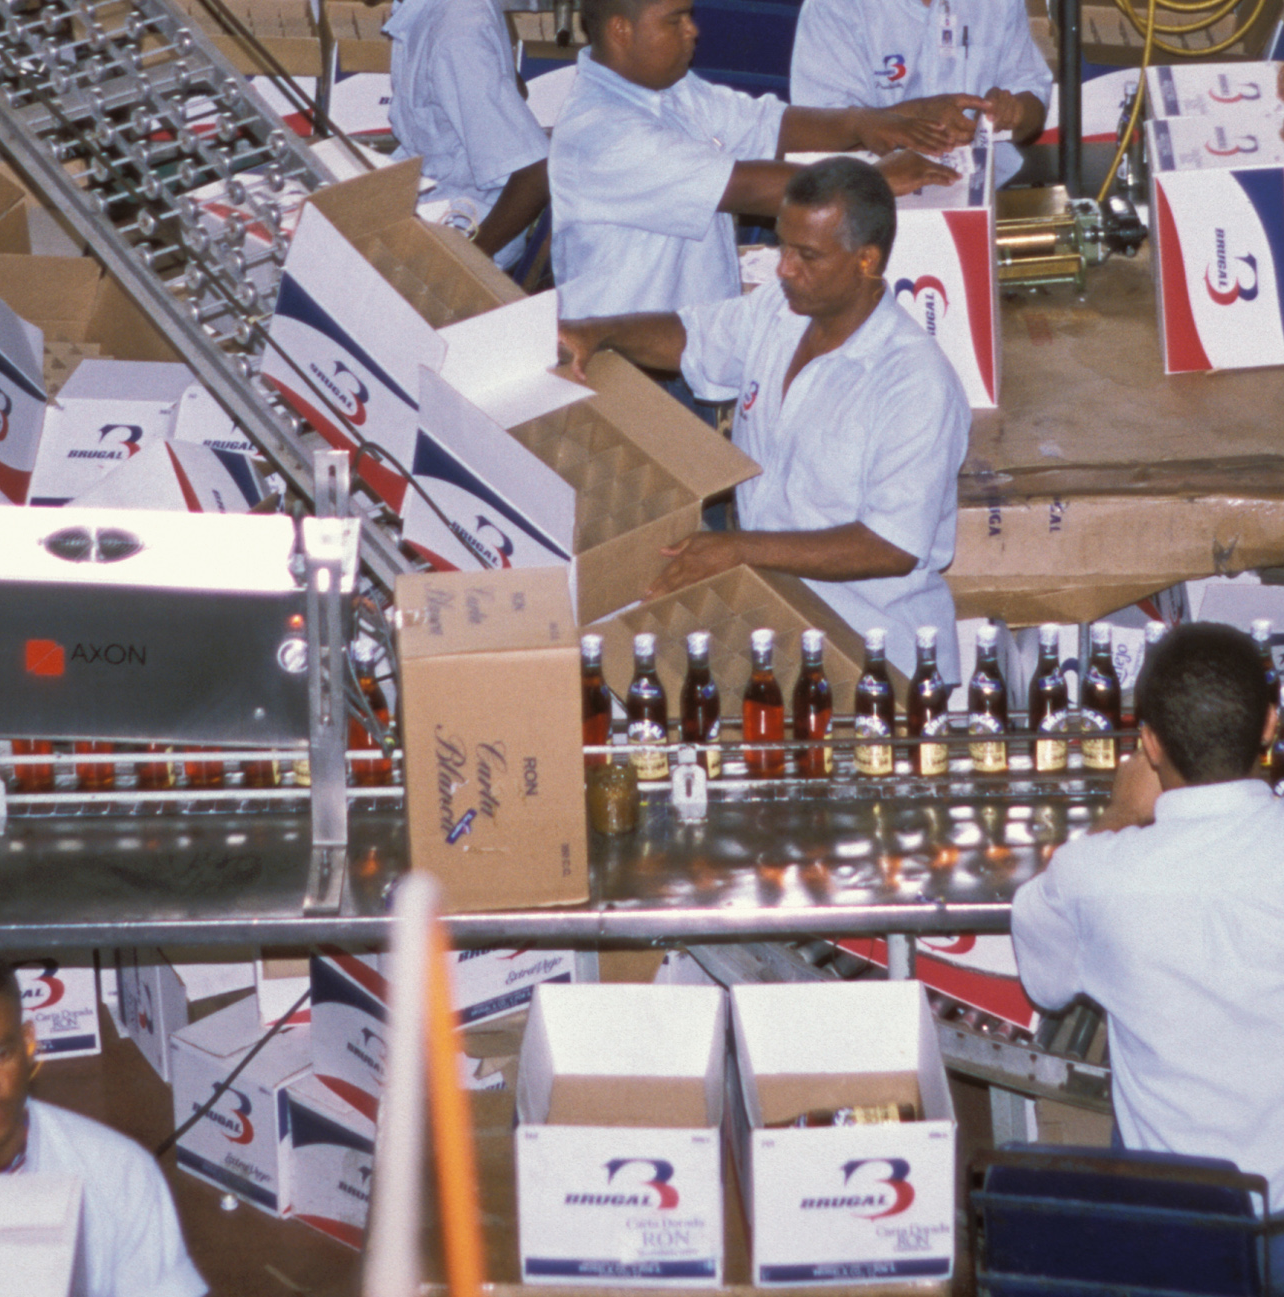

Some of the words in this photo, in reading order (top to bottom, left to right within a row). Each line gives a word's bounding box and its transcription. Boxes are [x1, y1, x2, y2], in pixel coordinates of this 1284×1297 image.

[1215, 228, 1229, 288] BRUGAL
[924, 292, 936, 337] UGAL
[67, 447, 124, 460] BRUGAL
[71, 644, 147, 666] AXON
[523, 757, 538, 796] RON
[565, 1193, 652, 1206] BRUGAL
[800, 1195, 886, 1209] BRUGAL
[642, 1231, 691, 1247] RON
